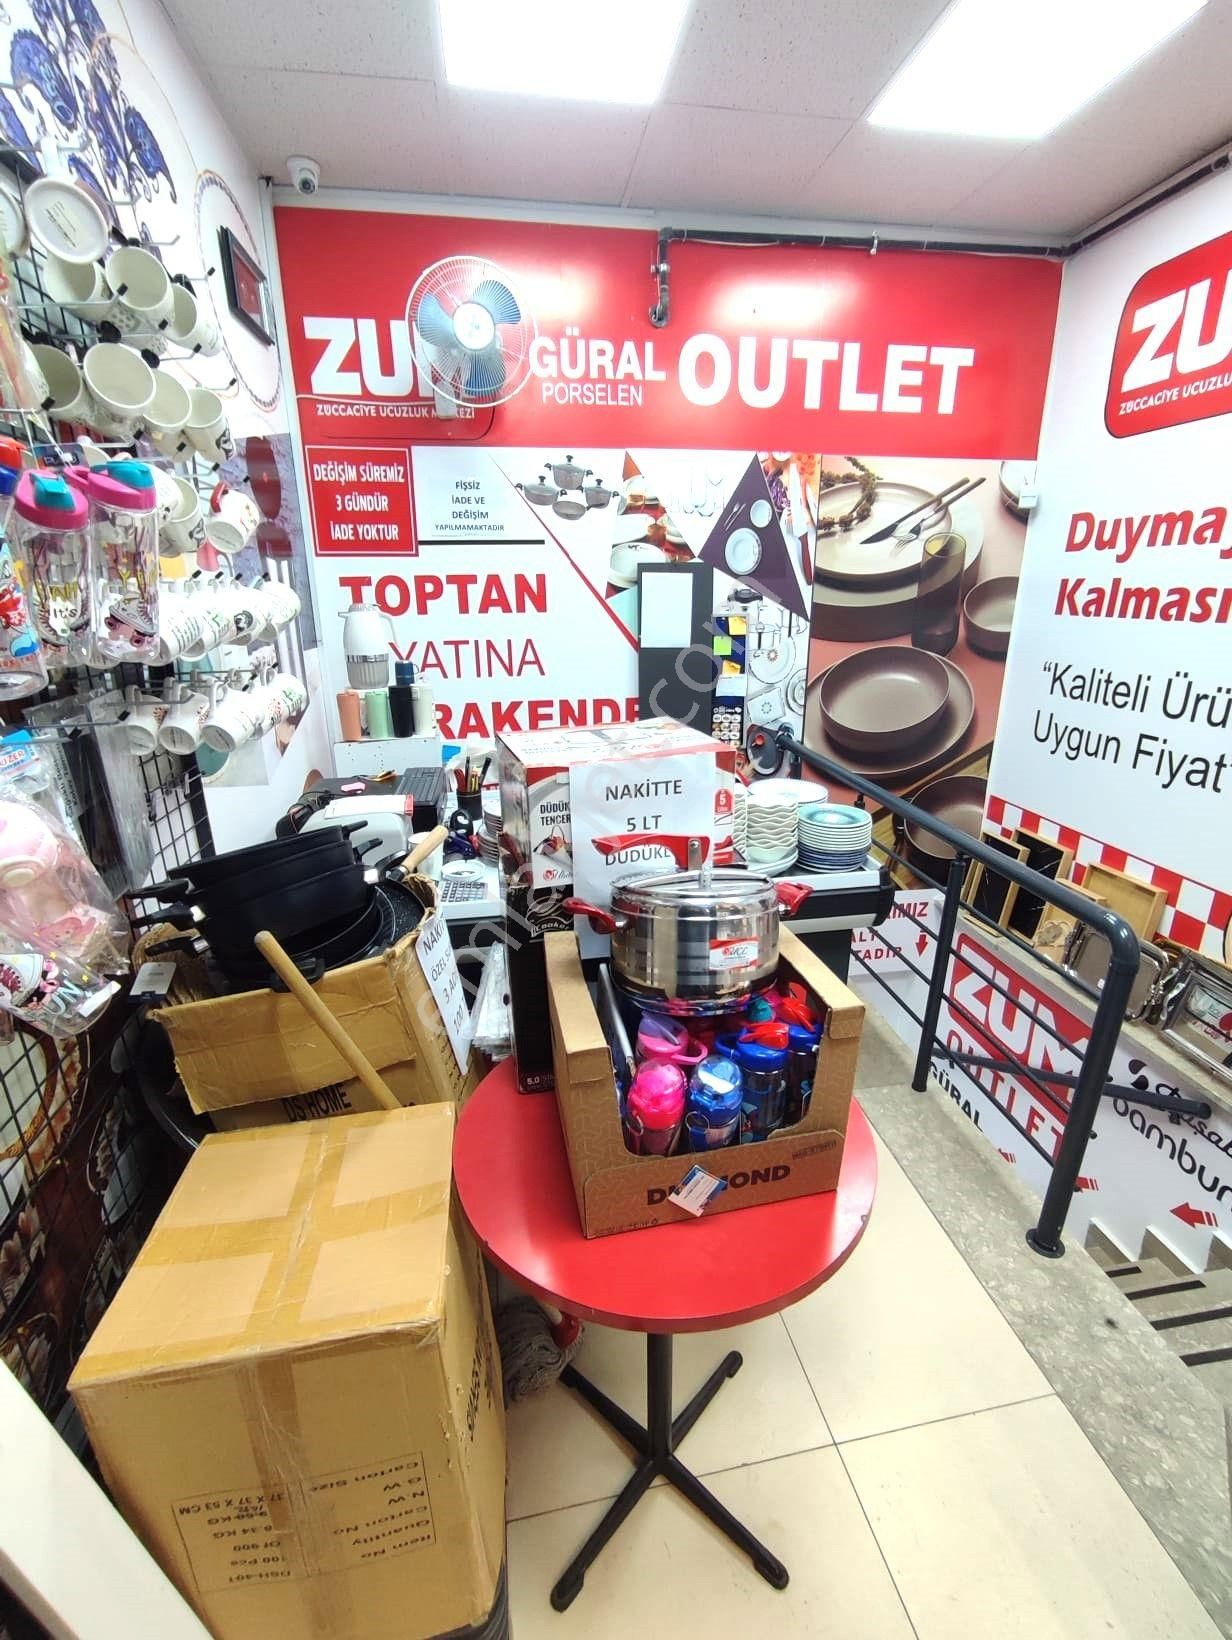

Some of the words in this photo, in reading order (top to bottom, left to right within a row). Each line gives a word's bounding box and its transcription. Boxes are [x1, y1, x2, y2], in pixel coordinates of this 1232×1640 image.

[529, 327, 666, 381] GÜRAL
[678, 333, 976, 415] OUTLET
[542, 383, 643, 407] PORSELEN
[379, 406, 429, 418] UCUZLUK
[313, 463, 357, 486] DEĞİŞİM
[360, 464, 405, 484] SÜREMİZ
[455, 479, 481, 493] FİŞSİZ
[336, 496, 342, 511] 3
[344, 493, 389, 513] GÜNDÜR
[451, 494, 473, 505] İADE
[474, 495, 486, 505] VE
[451, 508, 489, 522] DEĞİŞİM
[330, 522, 355, 541] İADE
[356, 521, 399, 541] YOKTUR
[1065, 505, 1232, 564] Duyma
[339, 574, 548, 616] TOPTAN
[1033, 708, 1121, 765] Uygun
[1131, 732, 1232, 794] Fiyat
[606, 779, 683, 802] NAKİTTE
[627, 817, 636, 832] 5
[642, 815, 662, 830] LT
[179, 1504, 201, 1516] CM
